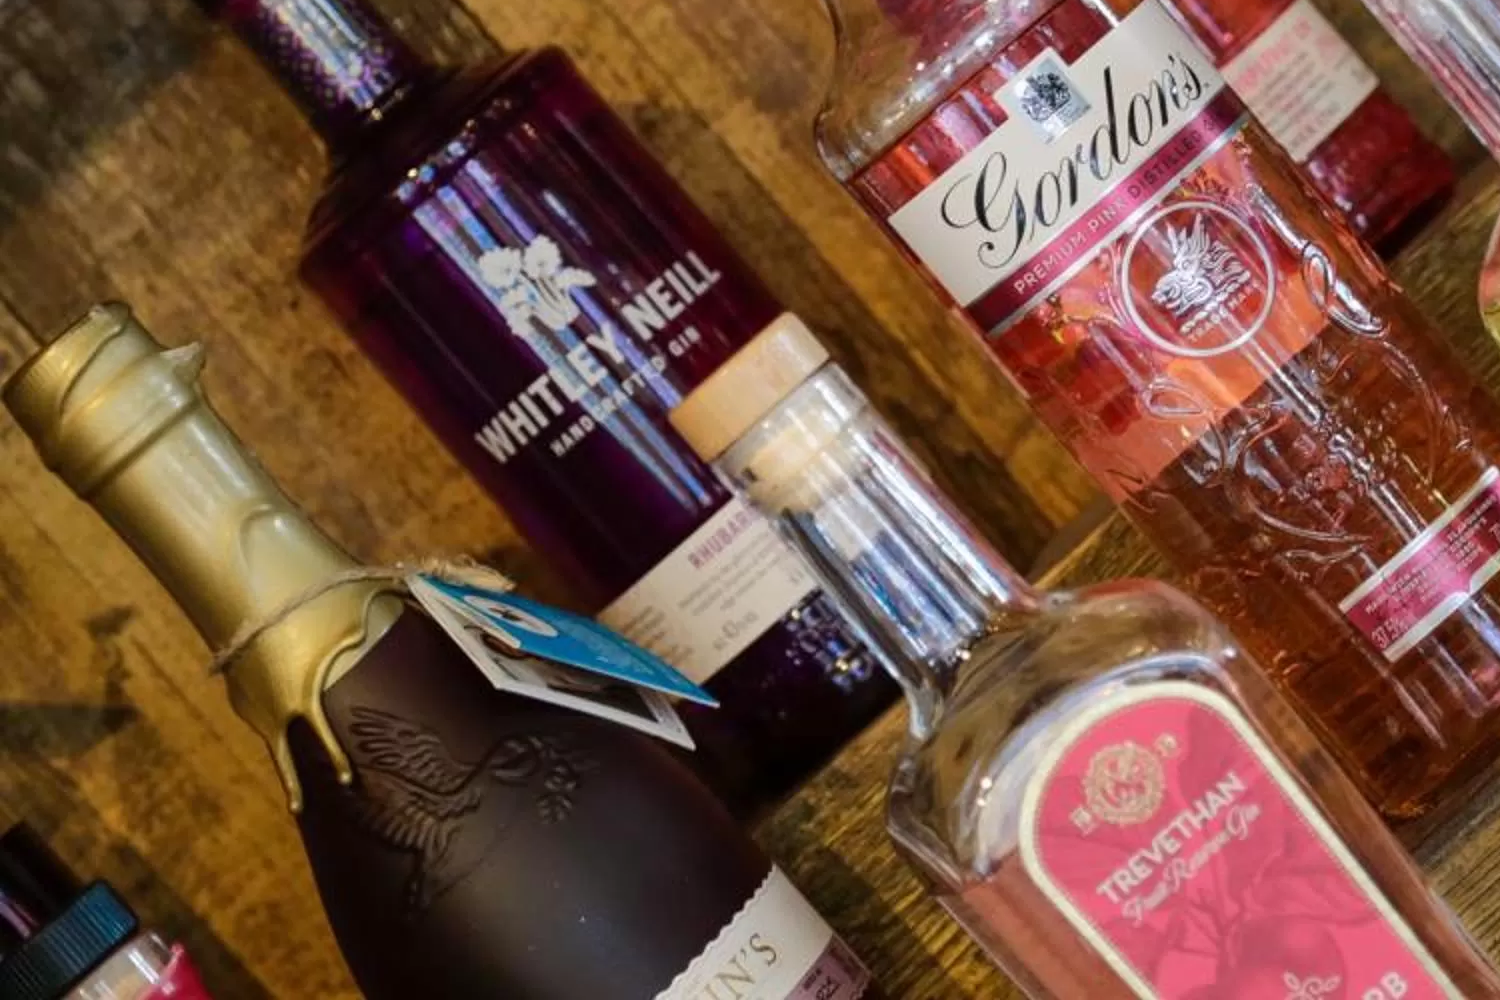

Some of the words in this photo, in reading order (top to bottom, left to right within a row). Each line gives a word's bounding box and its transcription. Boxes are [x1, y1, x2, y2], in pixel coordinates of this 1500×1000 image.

[940, 54, 1210, 271] Gordon's
[1012, 229, 1088, 296] PREMIUM
[1086, 194, 1129, 234] PINK
[472, 321, 629, 465] WHITLEY
[619, 248, 722, 343] NEILL
[667, 323, 703, 358] GIN
[1095, 768, 1247, 905] TREVETHAN
